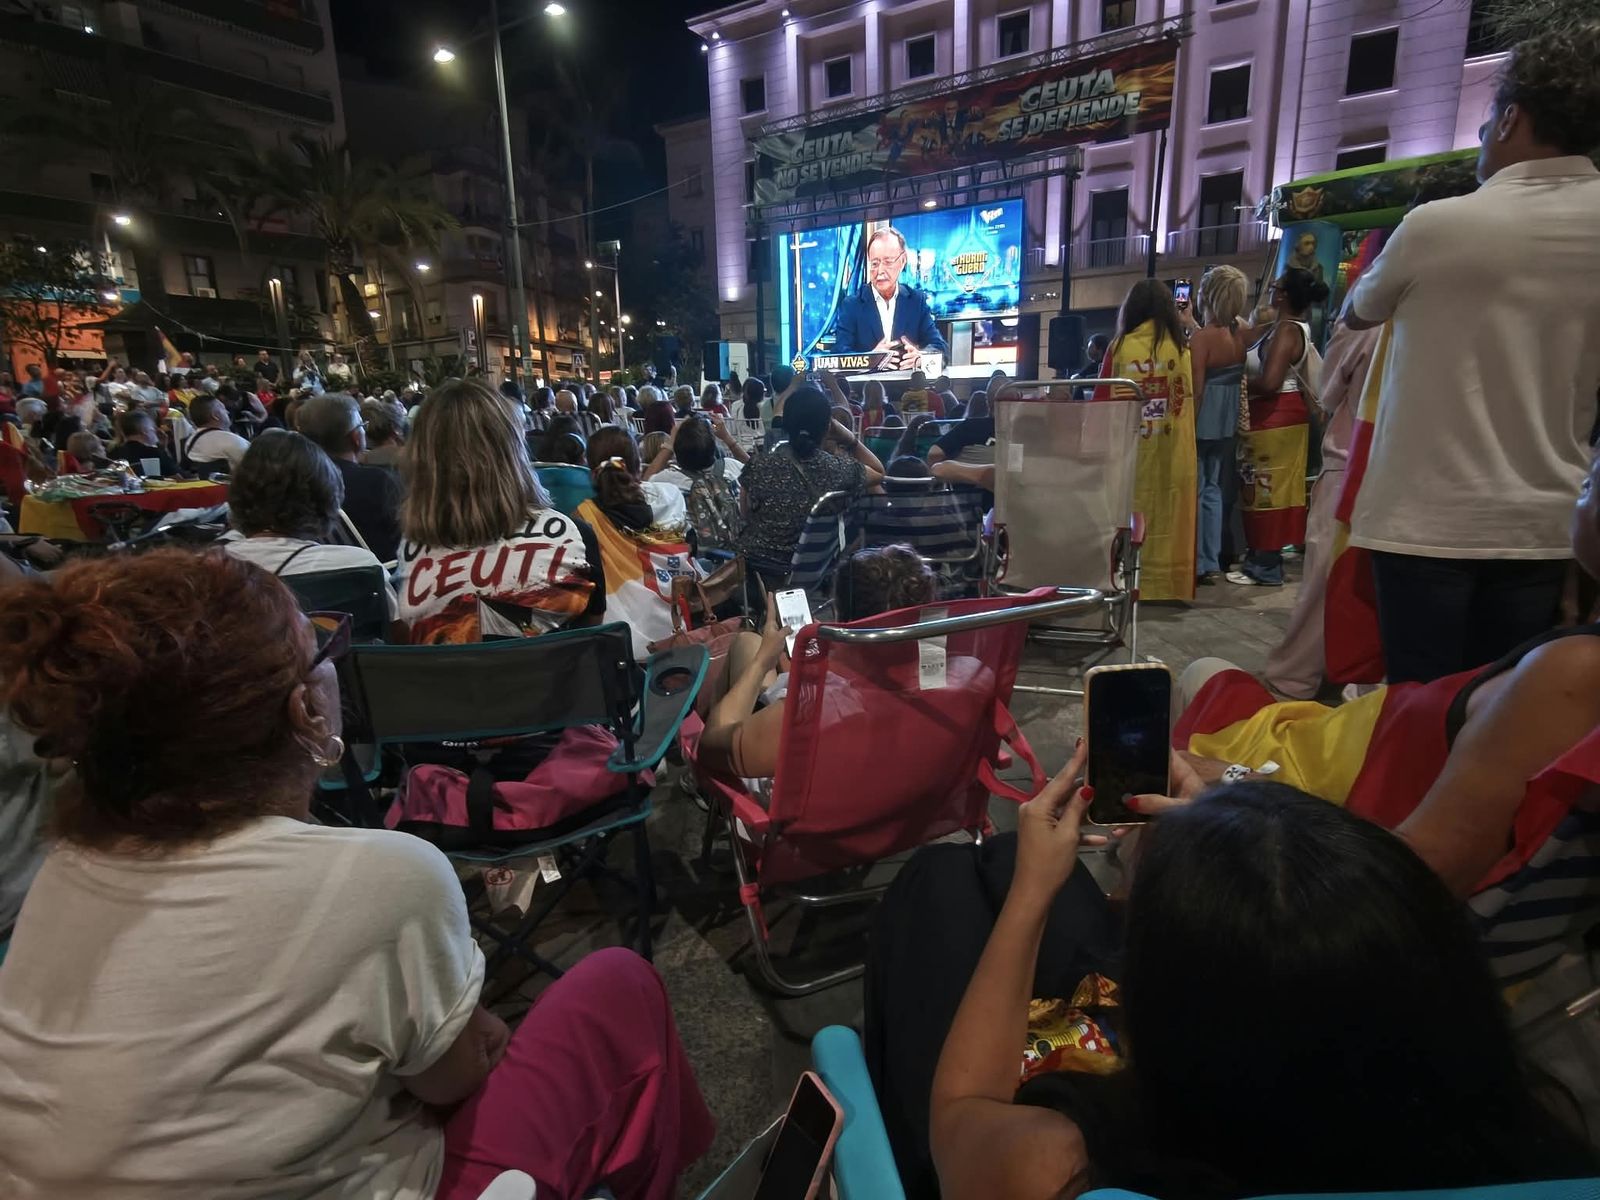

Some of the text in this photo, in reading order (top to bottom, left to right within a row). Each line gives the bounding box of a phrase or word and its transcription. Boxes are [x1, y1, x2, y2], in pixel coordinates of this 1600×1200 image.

[1019, 68, 1117, 112] CEUTA
[998, 91, 1141, 141] SE DEFIENDE
[791, 131, 856, 163] CEUTA
[776, 152, 873, 188] NO SE VENDE
[468, 330, 476, 345] P
[812, 356, 839, 371] JUAN
[840, 356, 870, 367] VIVAS
[407, 538, 574, 607] CEUTÍ
